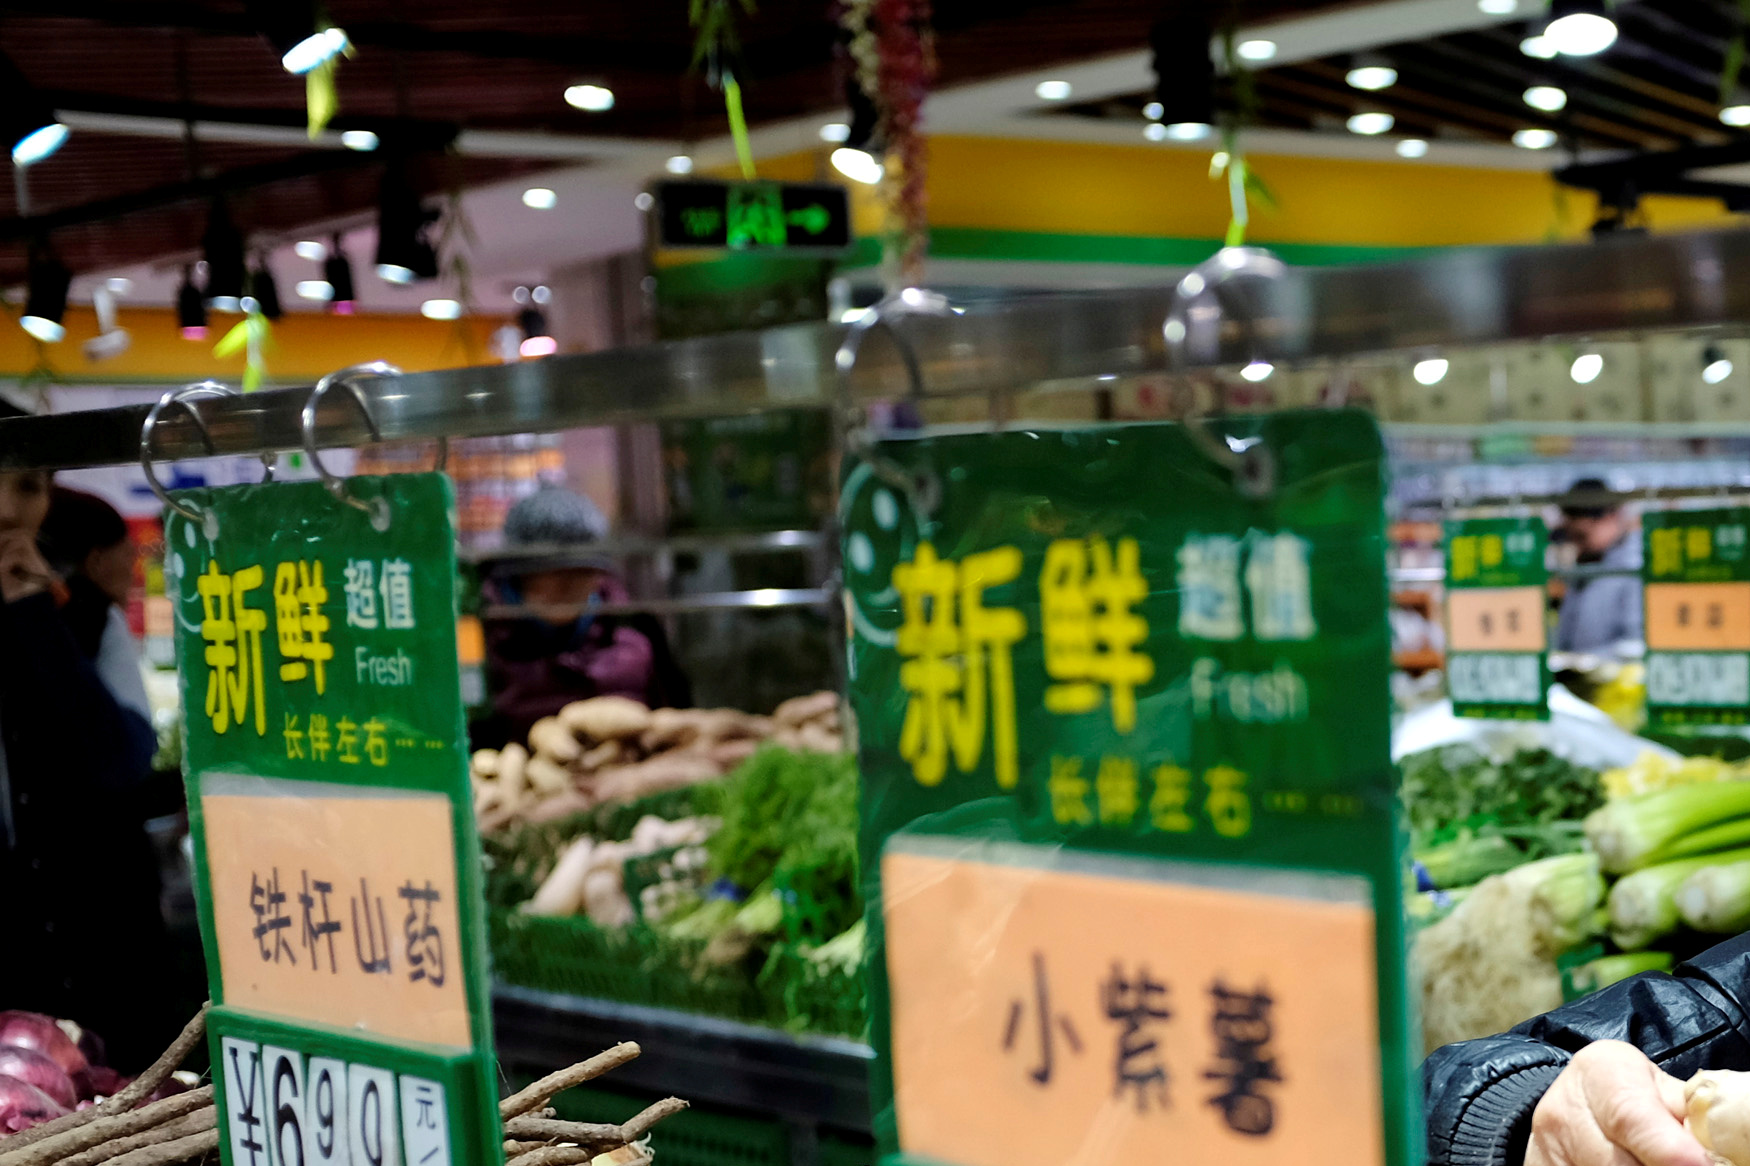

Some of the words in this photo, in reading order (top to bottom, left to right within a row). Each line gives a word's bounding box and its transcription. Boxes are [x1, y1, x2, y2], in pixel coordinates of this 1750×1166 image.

[197, 560, 333, 736] 新鲜
[343, 557, 415, 630] 超值
[354, 646, 413, 686] Fresh
[893, 533, 1154, 788] 新鲜
[250, 866, 446, 988] 铁杆山药
[1001, 951, 1284, 1140] 小紫薯
